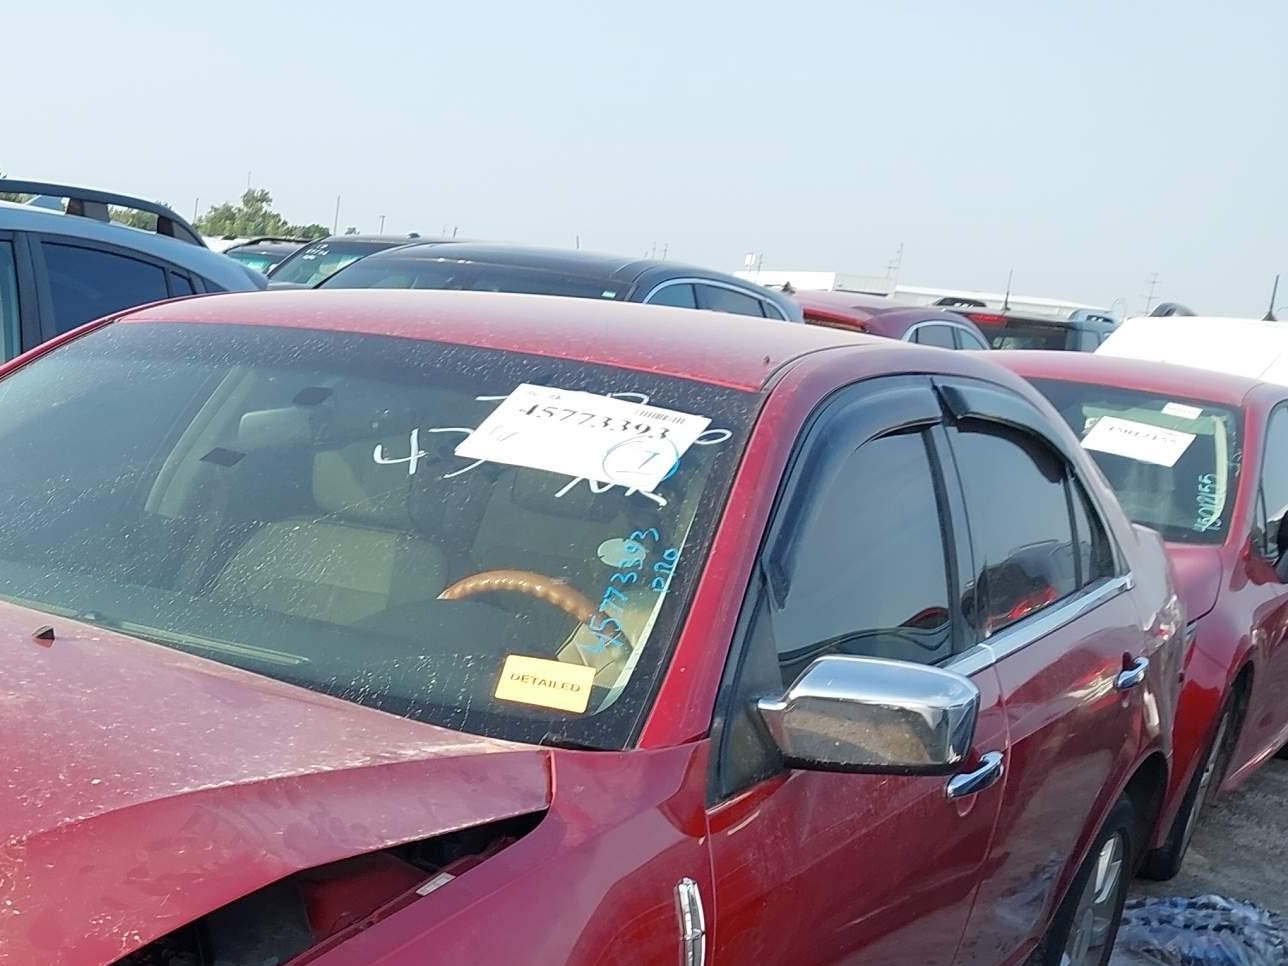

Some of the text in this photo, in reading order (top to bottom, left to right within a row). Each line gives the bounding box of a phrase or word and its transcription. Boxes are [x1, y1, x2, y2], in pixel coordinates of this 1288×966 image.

[518, 403, 670, 440] 45773393
[582, 527, 660, 654] 45773393
[510, 673, 582, 694] DETAILED
